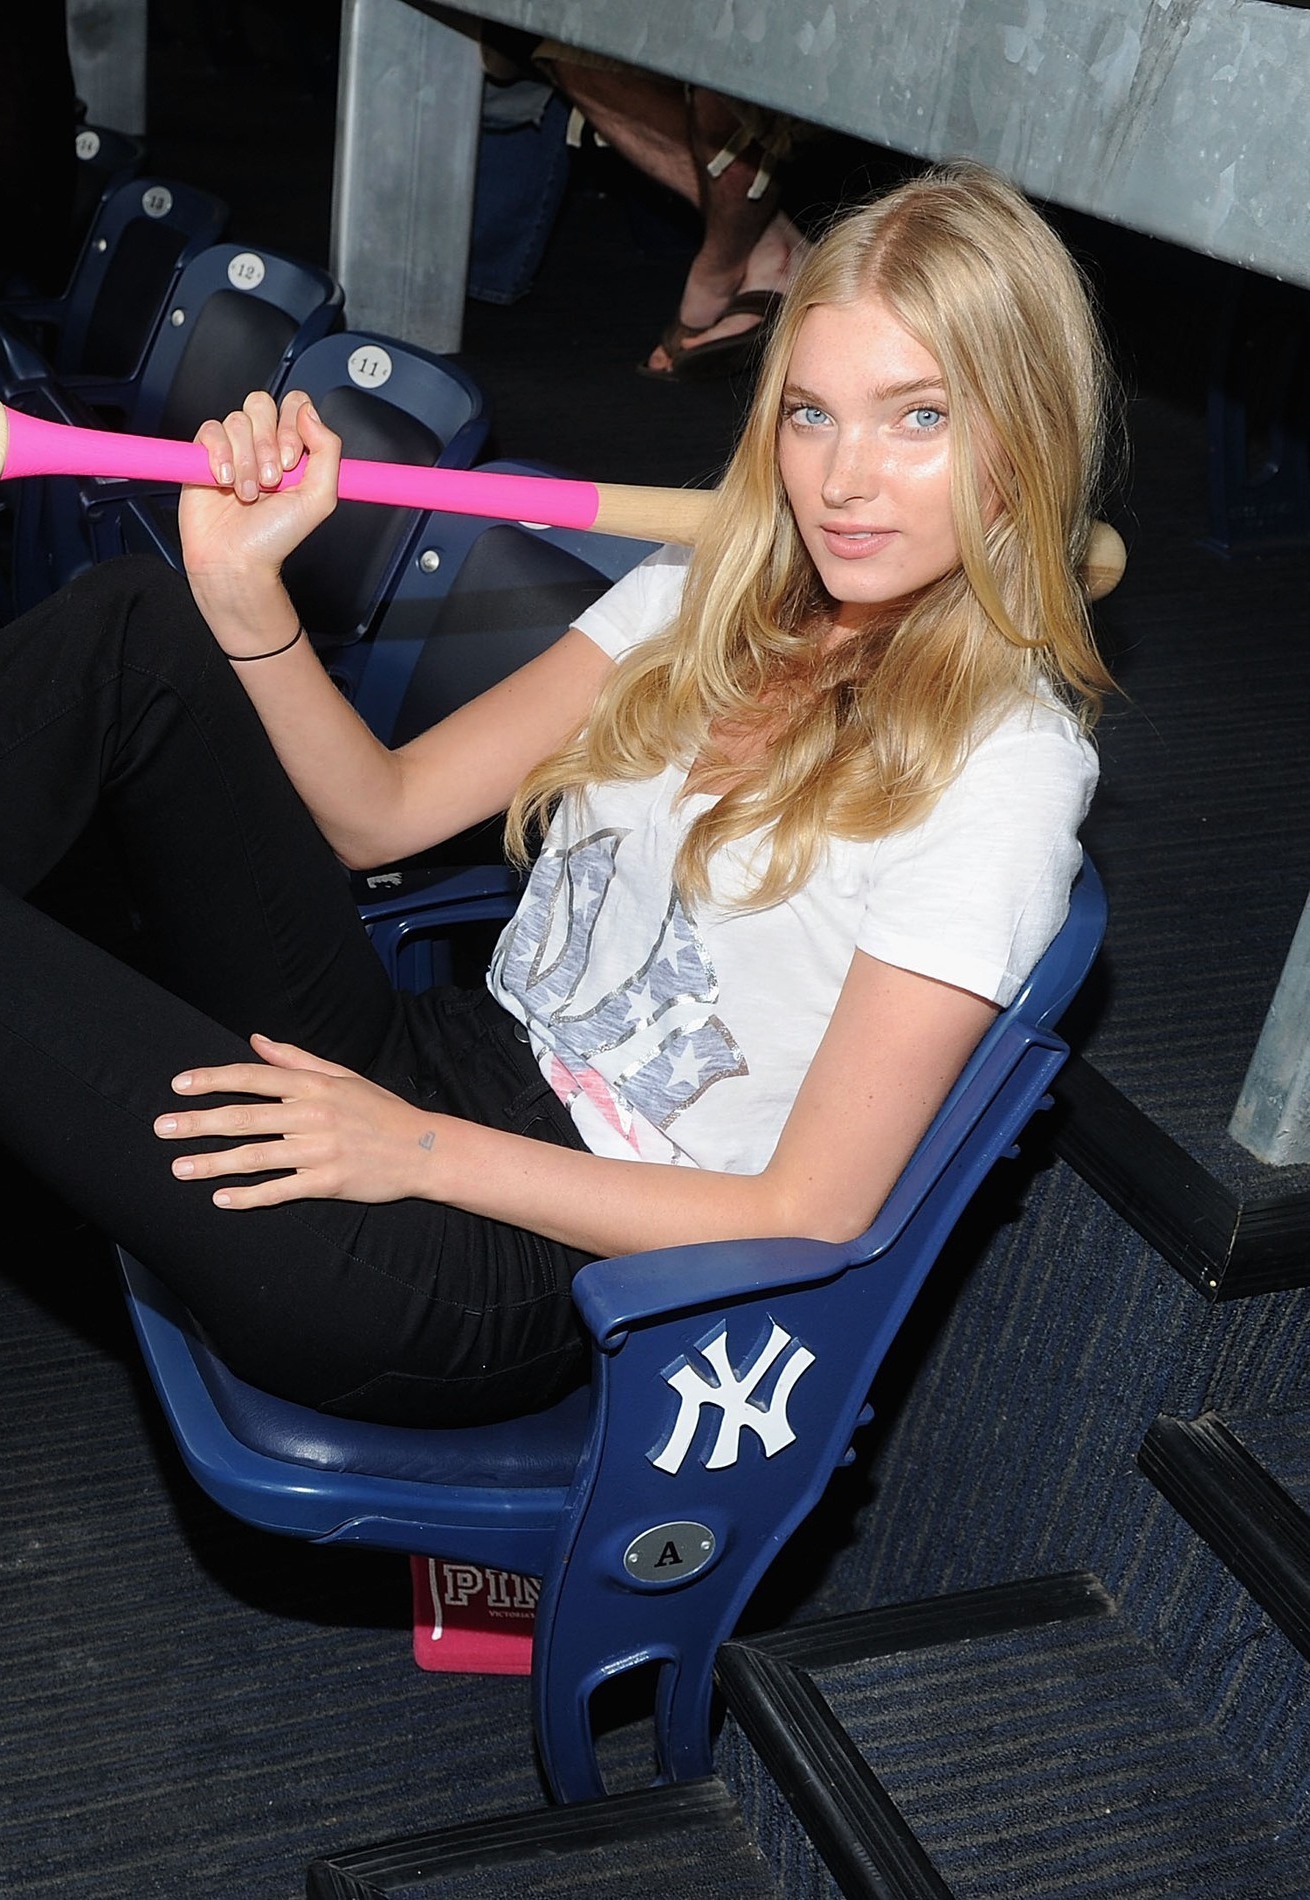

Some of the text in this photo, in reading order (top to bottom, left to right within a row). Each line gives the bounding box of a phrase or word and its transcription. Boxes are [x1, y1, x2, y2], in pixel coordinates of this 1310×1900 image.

[237, 263, 256, 280] 12
[358, 358, 379, 377] 11
[648, 1314, 816, 1475] NY
[654, 1541, 683, 1568] A
